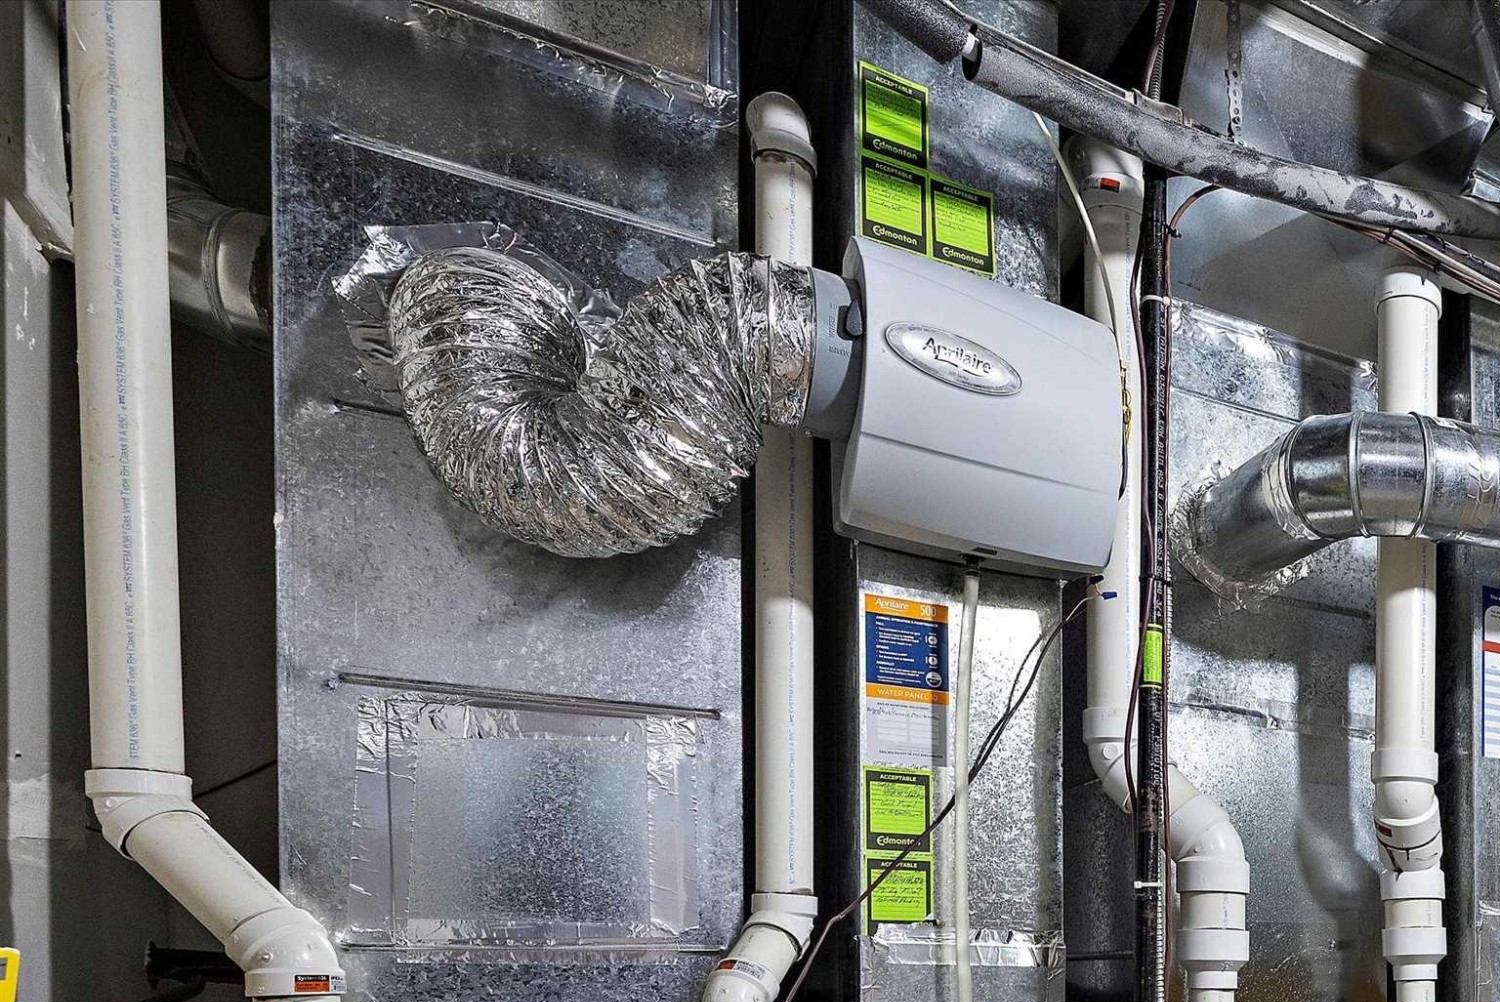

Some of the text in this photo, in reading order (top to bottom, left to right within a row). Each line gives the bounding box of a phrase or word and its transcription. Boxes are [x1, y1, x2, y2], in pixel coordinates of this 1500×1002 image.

[108, 96, 117, 113] Type
[108, 116, 117, 132] Vent
[108, 135, 118, 150] Gas
[873, 138, 918, 161] Edmonton
[873, 225, 918, 246] Edmonton
[942, 246, 985, 266] Edmonton
[113, 288, 123, 305] Type
[114, 307, 124, 324] Vent
[114, 326, 124, 340] Gas
[923, 337, 991, 373] Aprilaire
[121, 515, 130, 530] Gas
[920, 605, 936, 616] 500
[878, 688, 904, 696] WATER
[128, 704, 137, 718] Gas
[880, 774, 917, 782] ACCEPTABLE
[876, 835, 921, 846] Edmont
